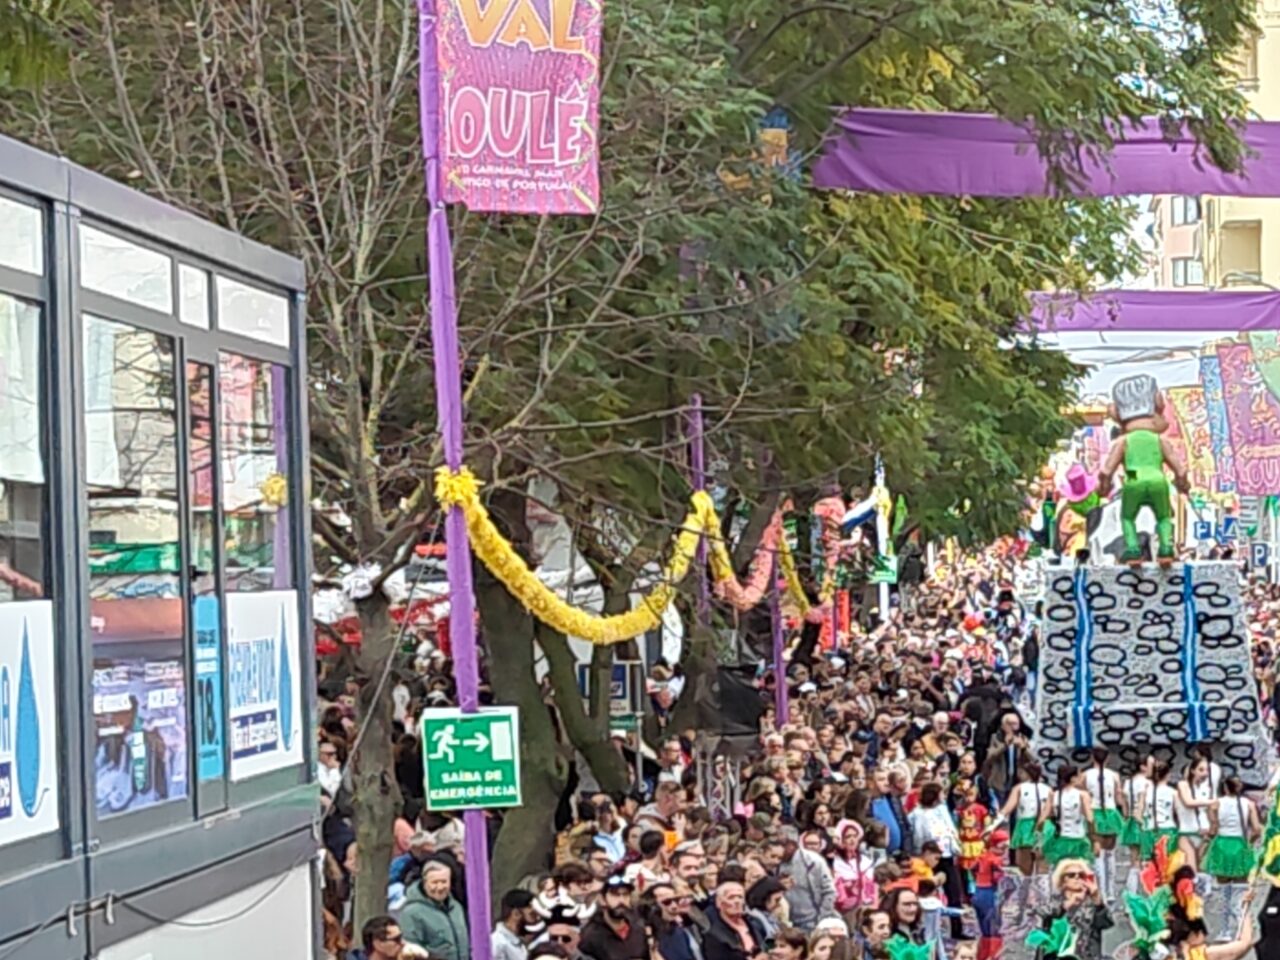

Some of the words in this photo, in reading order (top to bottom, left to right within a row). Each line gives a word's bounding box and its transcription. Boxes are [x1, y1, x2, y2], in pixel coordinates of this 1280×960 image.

[445, 79, 589, 168] OULÉ
[441, 769, 482, 783] SAÍDA
[484, 769, 503, 781] DE
[430, 784, 517, 800] EMERGÊNCIA
